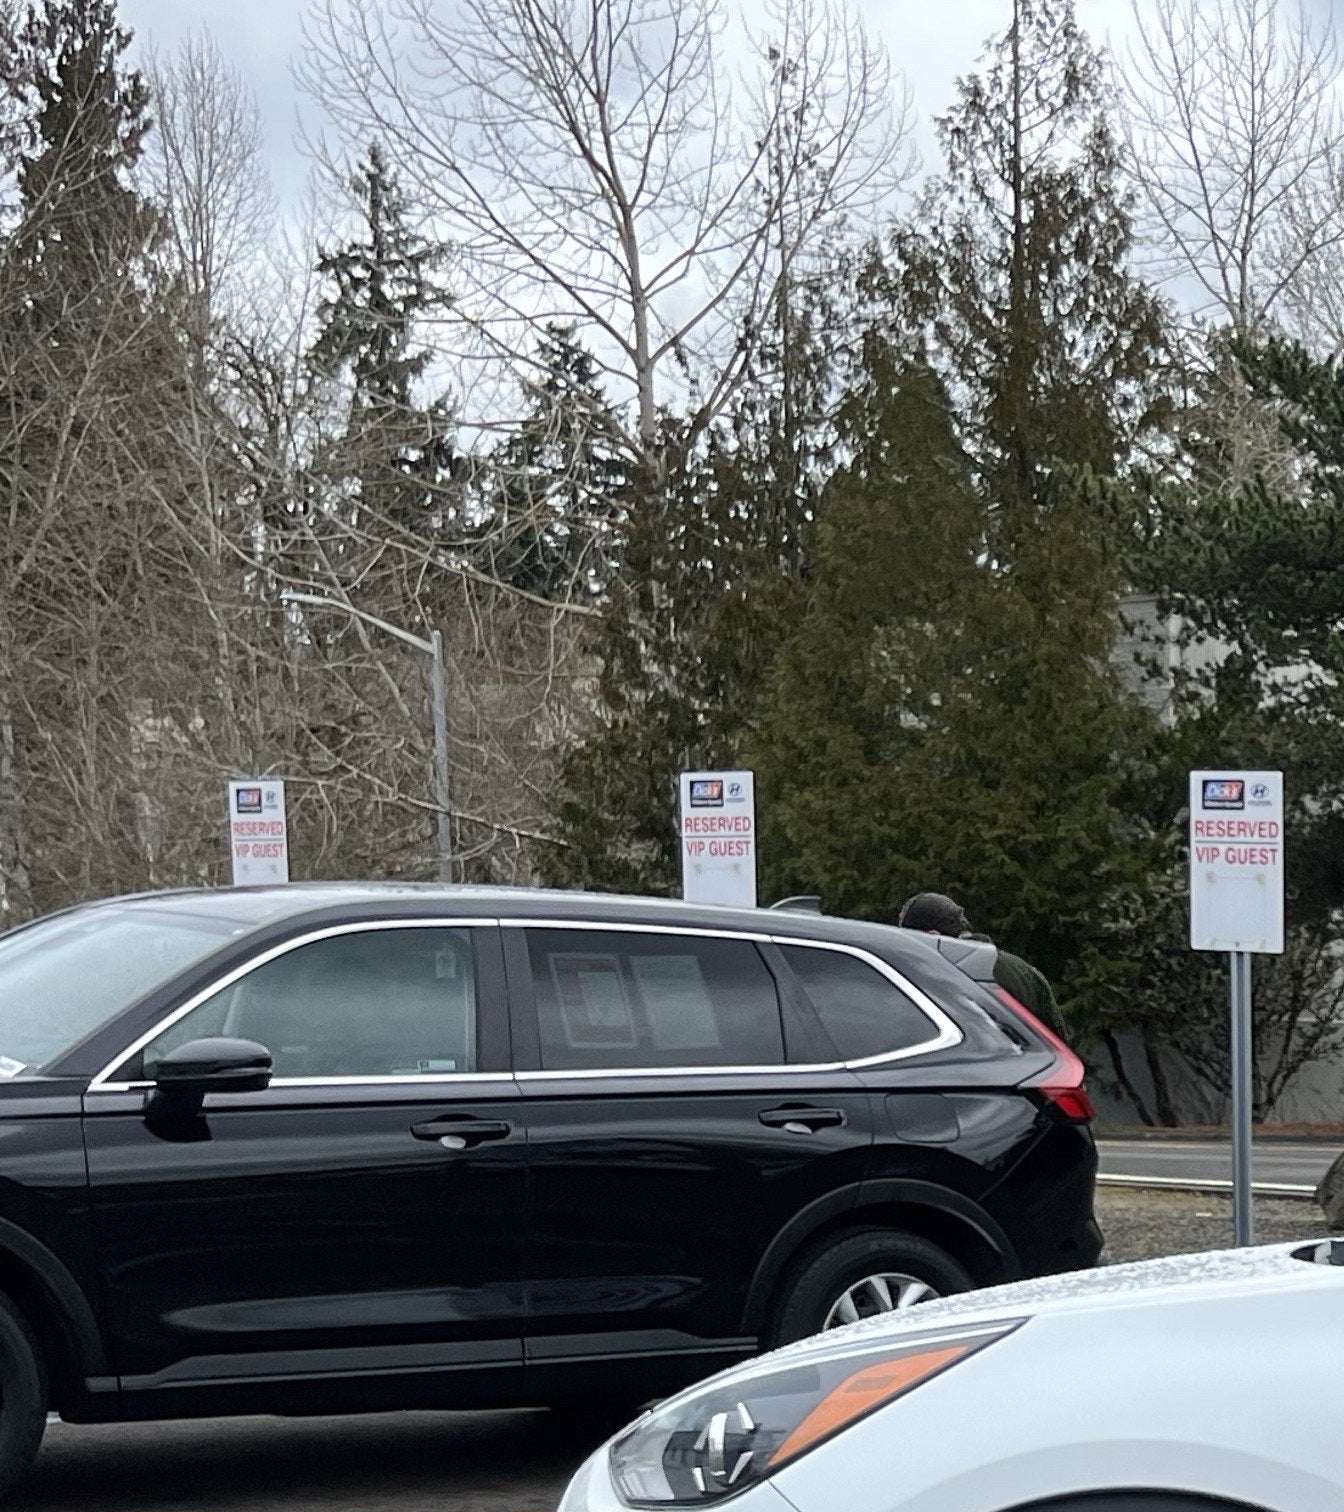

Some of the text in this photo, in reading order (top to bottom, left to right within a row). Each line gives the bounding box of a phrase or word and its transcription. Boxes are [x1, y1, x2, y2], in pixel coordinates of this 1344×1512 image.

[684, 816, 752, 833] RESERVED
[1194, 820, 1280, 839] RESERVED
[686, 840, 751, 857] VIP GUEST
[1195, 847, 1279, 865] VIP GUEST
